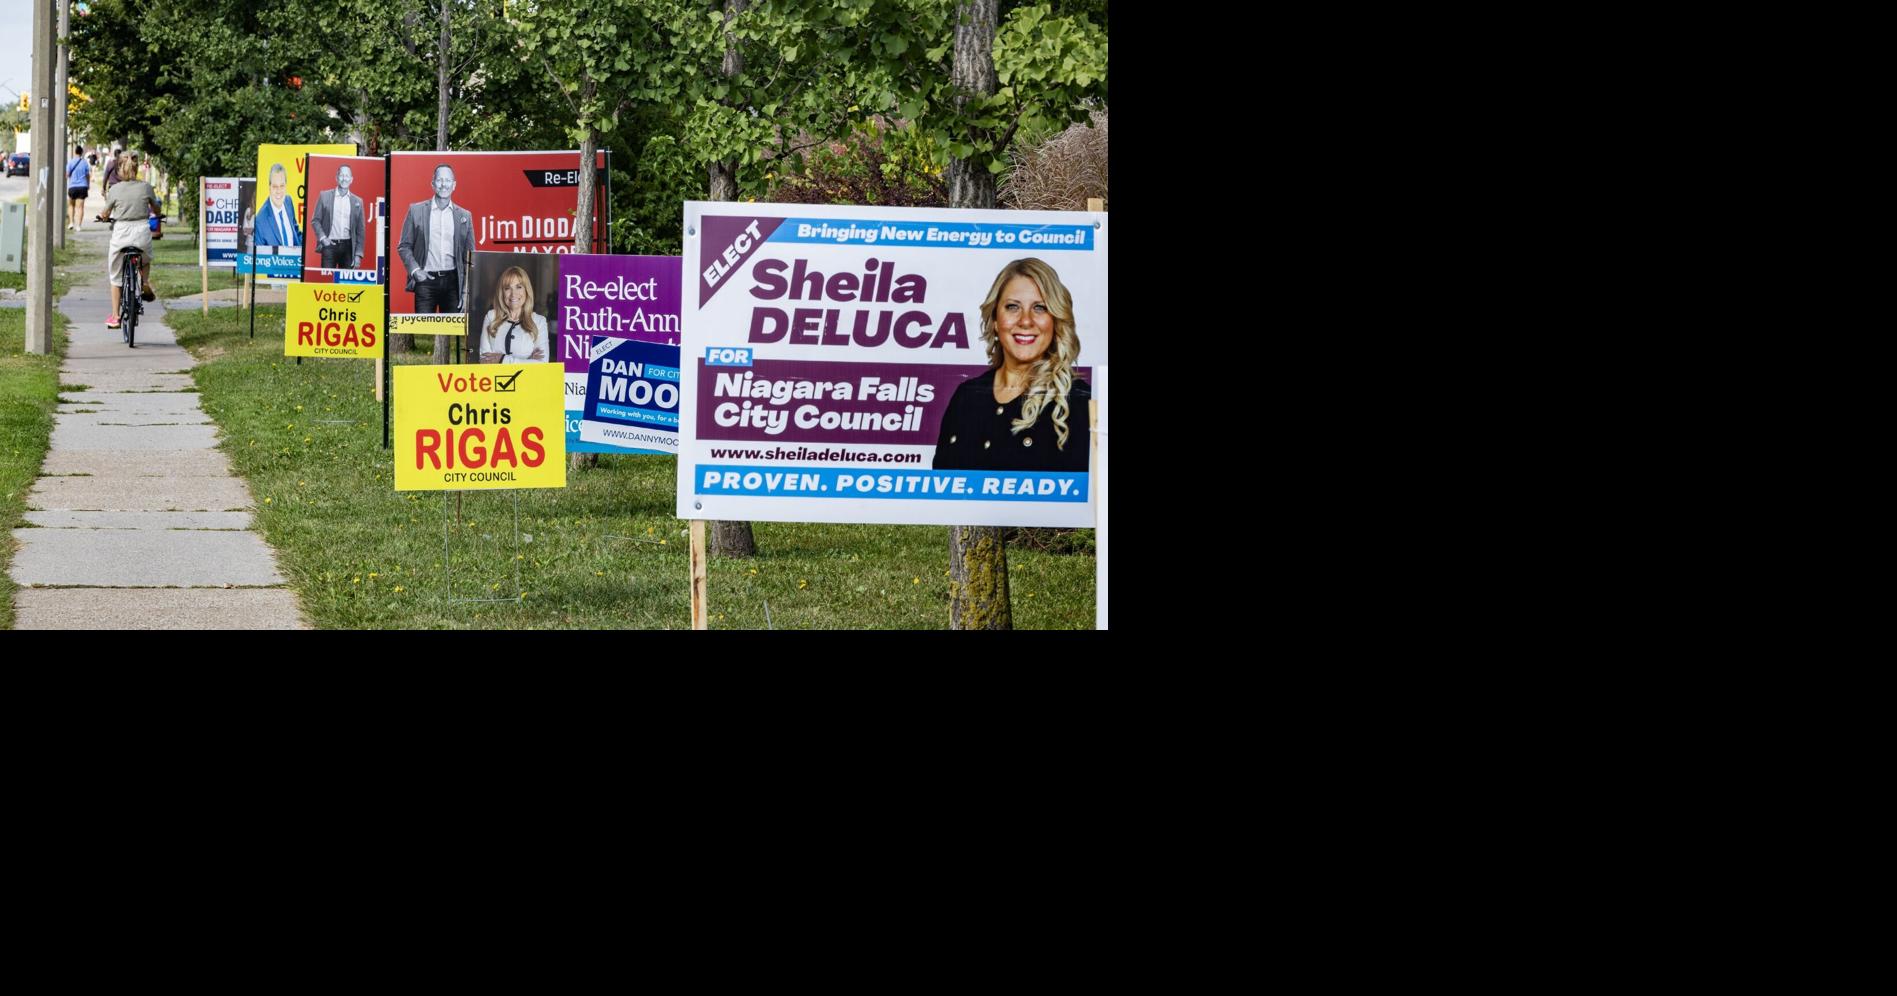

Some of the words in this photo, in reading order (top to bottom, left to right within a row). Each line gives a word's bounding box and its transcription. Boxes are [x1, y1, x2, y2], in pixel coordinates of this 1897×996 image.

[479, 215, 517, 245] Jim
[797, 223, 877, 242] Bringing
[880, 226, 923, 241] New
[926, 228, 992, 246] Energy
[994, 232, 1015, 243] to
[1017, 230, 1086, 245] Council
[244, 255, 271, 267] Stong
[271, 256, 296, 266] Voice.
[702, 219, 762, 288] ELECT
[564, 274, 658, 301] Re-elect
[749, 257, 927, 304] Sheila
[314, 289, 346, 302] Vote
[319, 307, 357, 321] Chris
[563, 305, 681, 333] Ruth-Ann
[298, 321, 376, 347] RIGAS
[747, 306, 970, 349] DELUCA
[595, 341, 613, 355] ELECT
[708, 349, 749, 364] FOR
[601, 358, 643, 378] DAN
[648, 368, 665, 377] FOR
[437, 372, 492, 392] Vote
[599, 375, 679, 409] MOO
[714, 371, 853, 405] Niagara
[857, 377, 935, 403] Falls
[448, 402, 511, 425] Chris
[600, 407, 627, 417] Working
[657, 414, 667, 422] for
[714, 401, 789, 435] City
[794, 405, 924, 432] Council
[416, 426, 546, 470] RIGAS
[710, 446, 921, 463] www.sheiladeluca.com
[444, 473, 467, 482] CITY
[469, 472, 517, 481] COUNCIL
[703, 471, 827, 492] PROVEN.
[835, 475, 974, 494] POSITIVE.
[982, 480, 1080, 496] READY.
